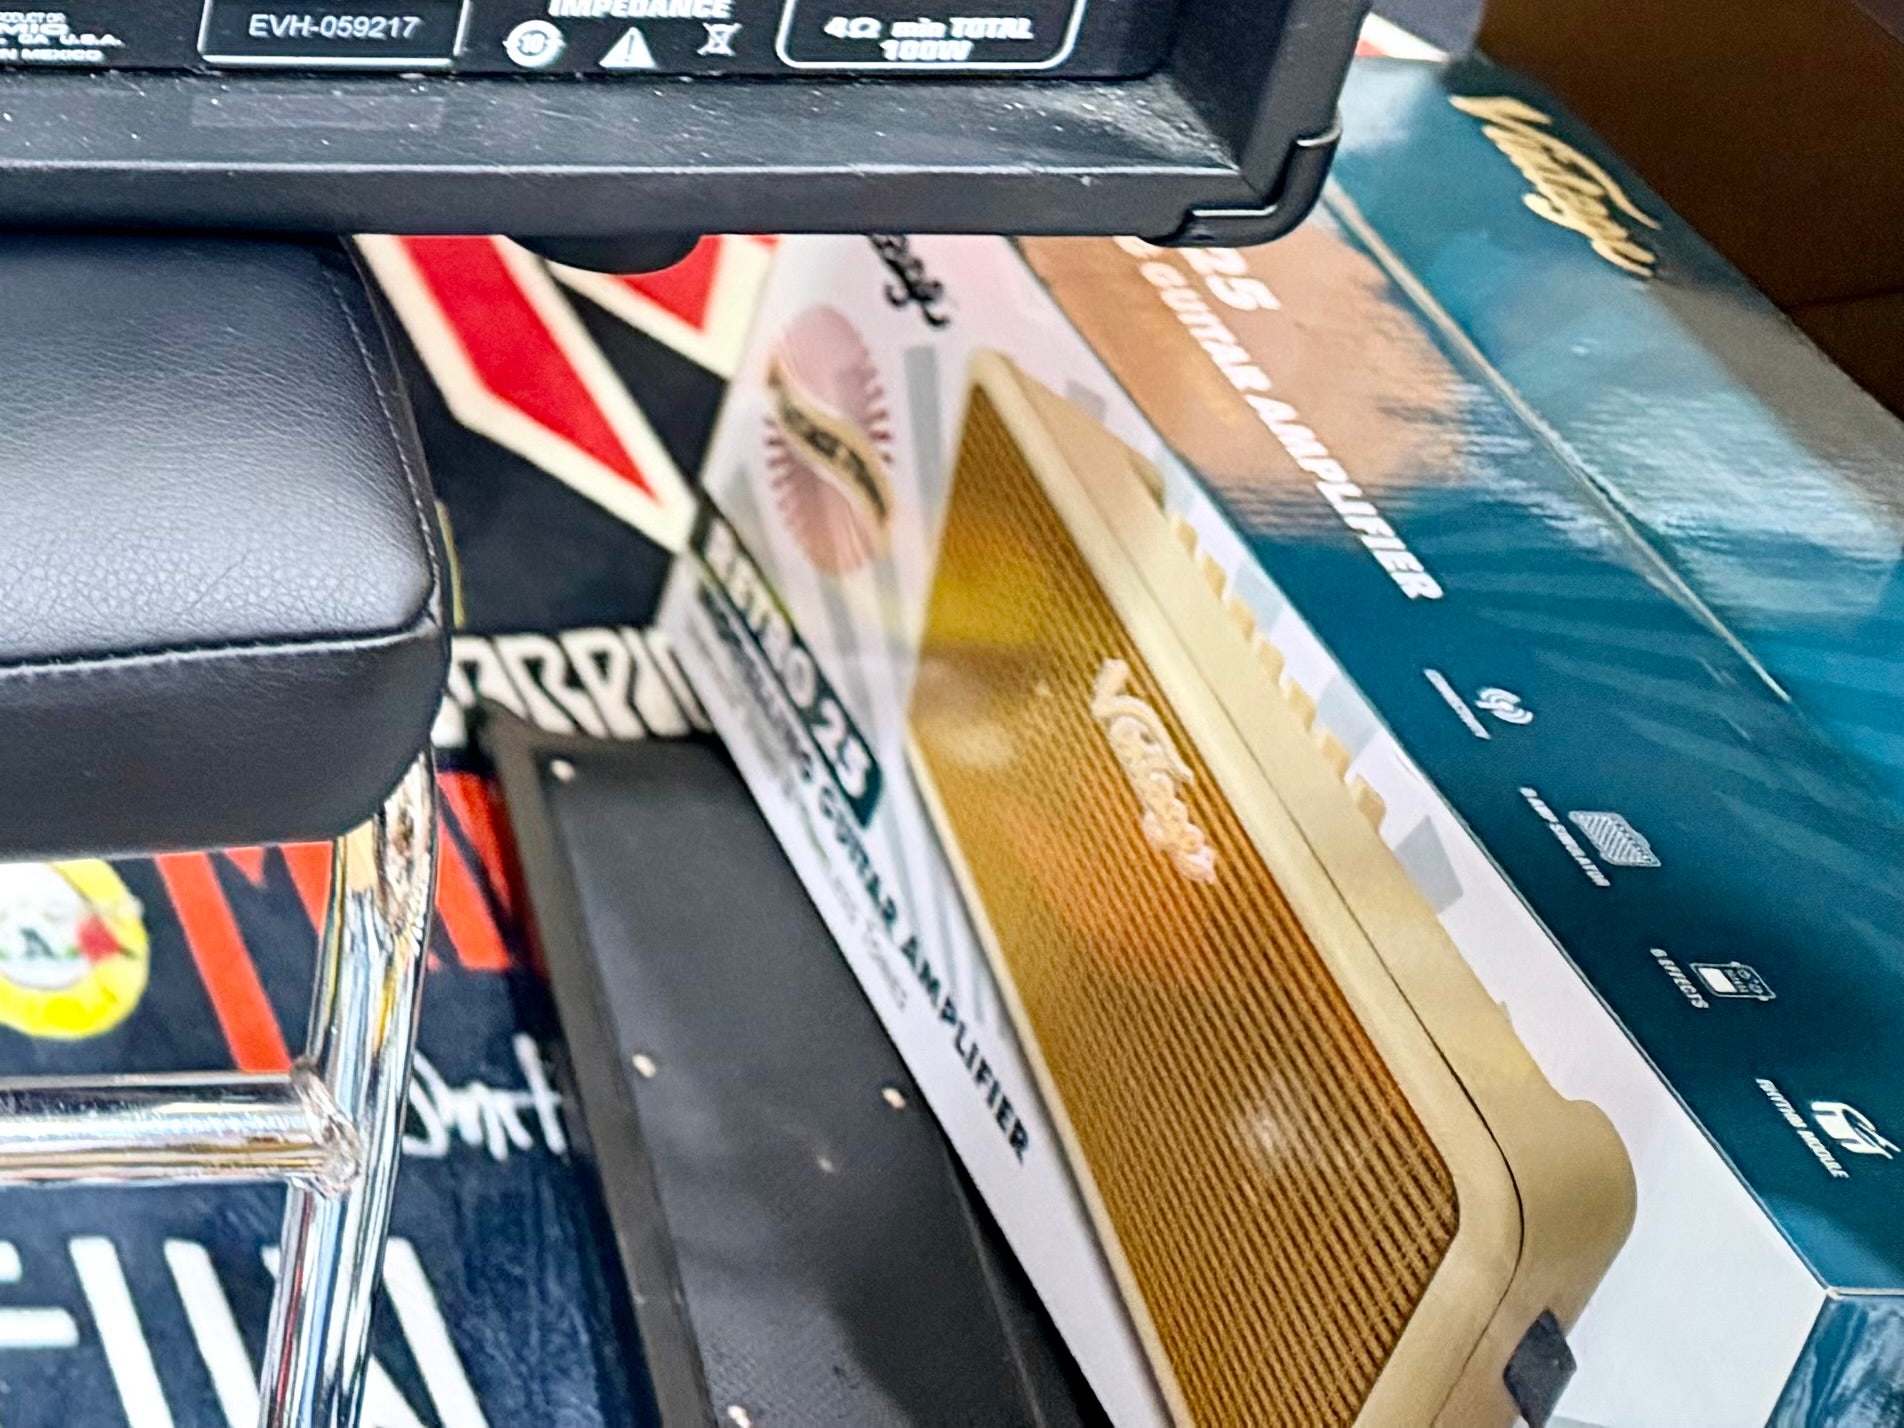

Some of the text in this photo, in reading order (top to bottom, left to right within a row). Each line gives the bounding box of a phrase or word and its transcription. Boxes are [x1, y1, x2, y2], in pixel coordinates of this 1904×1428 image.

[248, 14, 423, 40] EVH-059217
[949, 17, 1034, 39] TOTAL
[21, 49, 105, 63] MEXICO
[880, 40, 974, 62] 100W
[1140, 261, 1444, 600] GUITAR AMPLIFIER
[899, 934, 1030, 1165] AMPLIFIER
